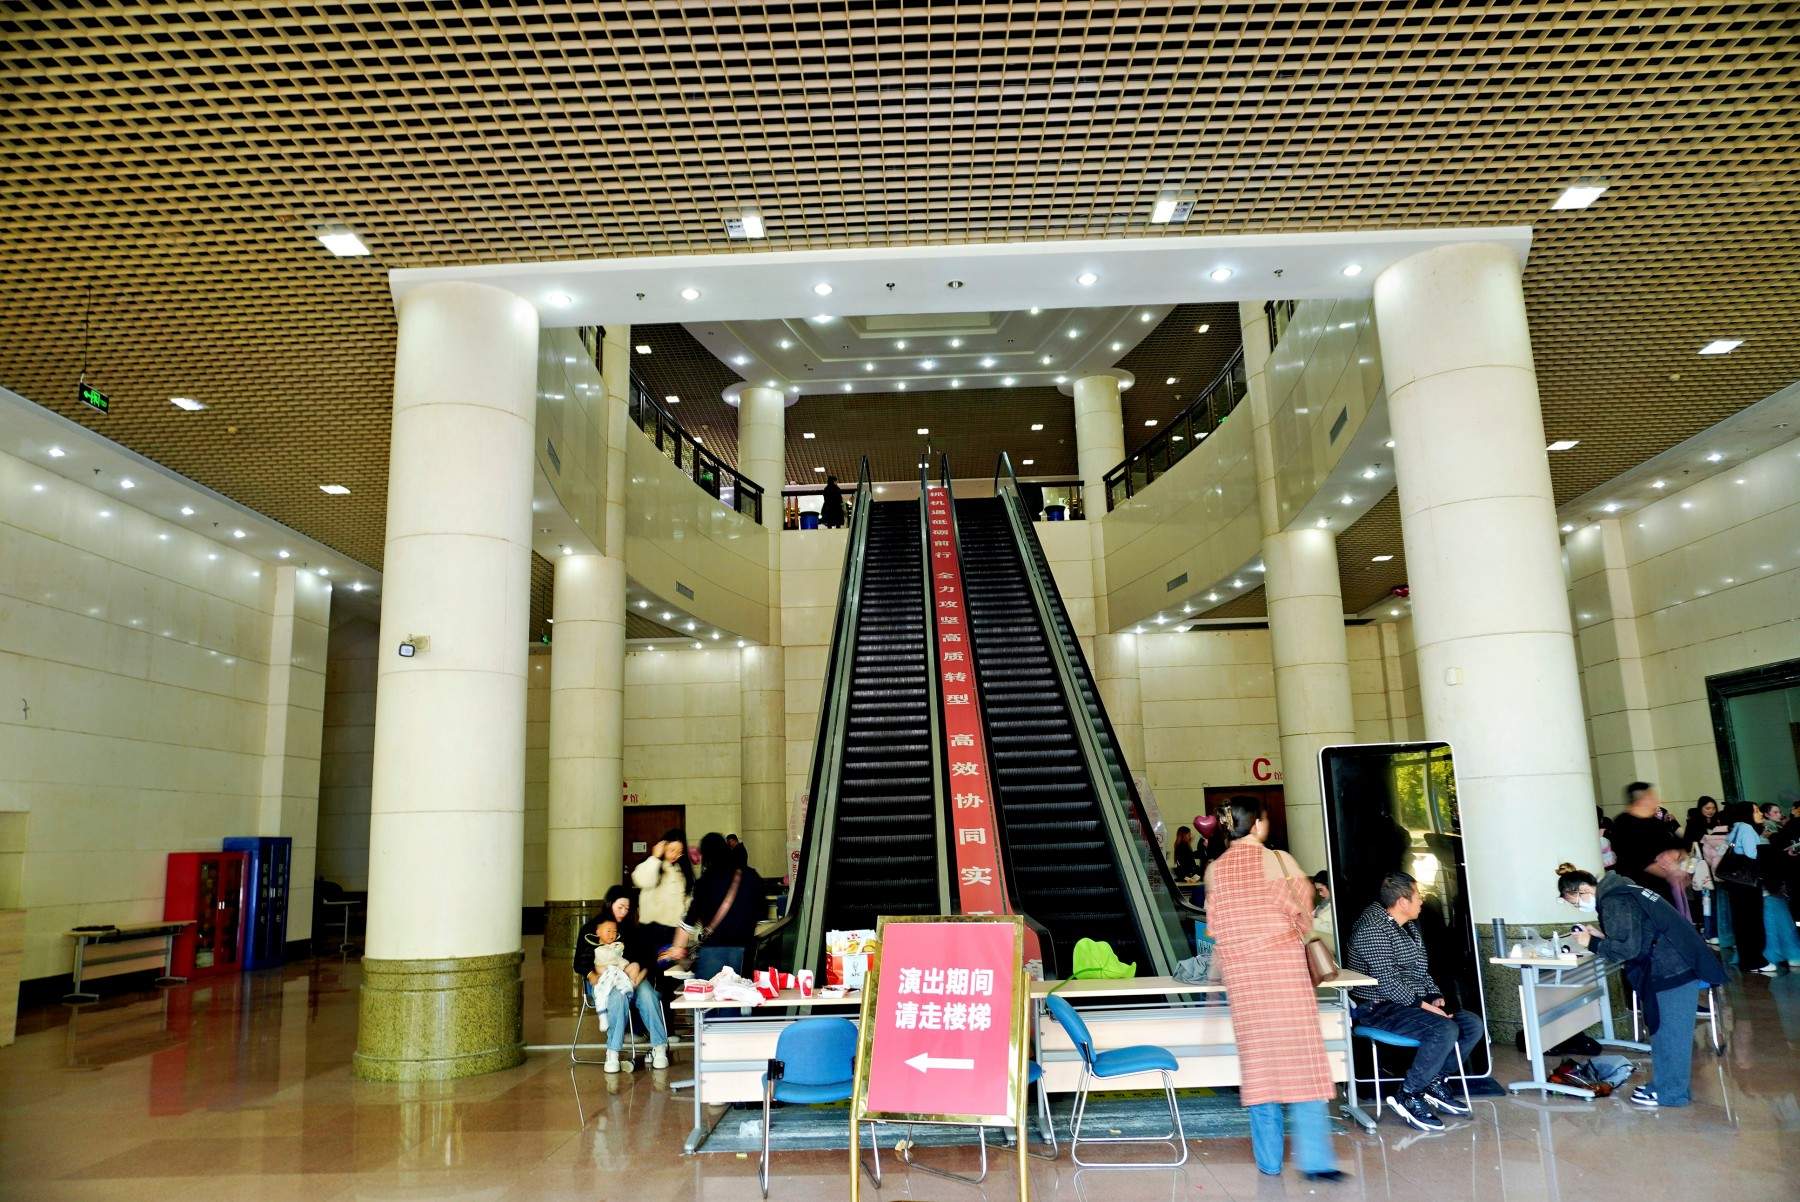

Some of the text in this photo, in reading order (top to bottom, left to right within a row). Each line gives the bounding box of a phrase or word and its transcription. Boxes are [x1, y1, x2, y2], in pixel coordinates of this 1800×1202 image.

[937, 572, 969, 705] 全力攻坚高质转型
[950, 733, 993, 916] 高效协同实
[895, 1001, 992, 1031] 请走楼梯
[898, 967, 994, 996] 演出期间
